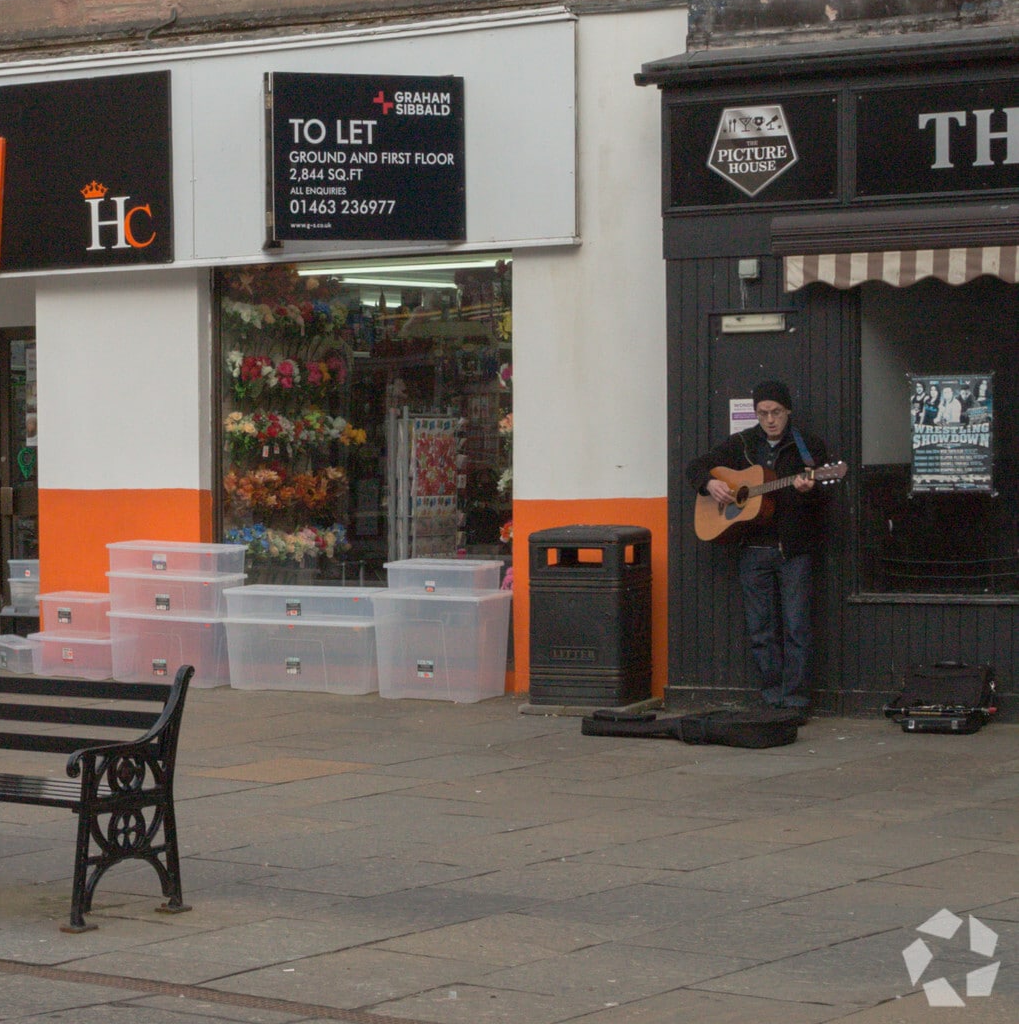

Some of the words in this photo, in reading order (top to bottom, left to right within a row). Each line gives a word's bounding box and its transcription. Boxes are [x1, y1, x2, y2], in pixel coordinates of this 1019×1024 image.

[394, 91, 451, 104] GRAHAM
[396, 104, 451, 116] SIBBALD
[288, 118, 327, 145] TO
[336, 119, 377, 145] LET
[289, 151, 347, 165] GROUND
[349, 152, 378, 165] AND
[381, 152, 411, 165] FIRST
[414, 152, 455, 166] FLOOR
[718, 145, 788, 163] PICTURE
[728, 160, 777, 174] HOUSE
[289, 168, 324, 183] 2,844
[328, 168, 363, 182] SQ.FT
[290, 186, 304, 195] ALL
[305, 186, 348, 196] ENQUIRIES
[289, 199, 336, 215] 01463
[340, 199, 396, 215] 236977
[912, 433, 990, 450] SHOWDOWN
